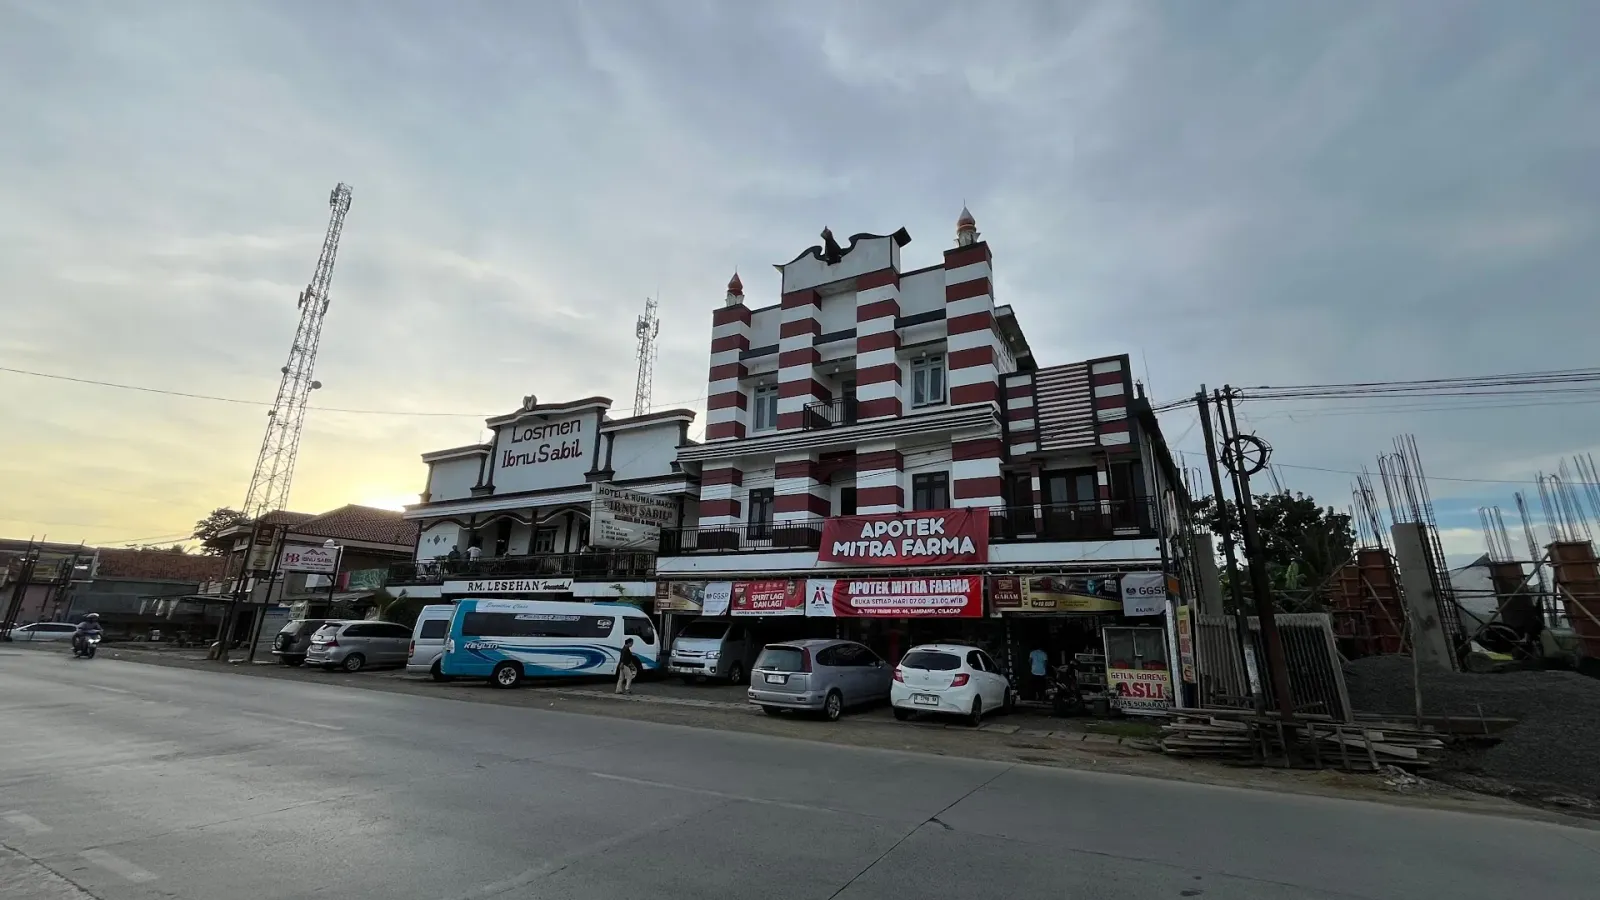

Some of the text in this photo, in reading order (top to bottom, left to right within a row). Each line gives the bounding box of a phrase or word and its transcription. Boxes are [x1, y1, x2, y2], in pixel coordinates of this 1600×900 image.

[511, 420, 581, 443] Losmen
[502, 439, 582, 468] Ibnu Sabil
[599, 487, 623, 498] HOTEL
[631, 494, 655, 505] RUMAH
[656, 499, 678, 510] MAKAN
[860, 517, 945, 539] APOTEK
[832, 536, 976, 557] MITRA FARMA
[468, 582, 485, 591] RM.
[487, 581, 540, 591] LESEHAN
[848, 579, 970, 595] APOTEK MITRA FARMA
[751, 593, 770, 602] SPIRIT
[770, 592, 785, 600] LAGI
[768, 600, 782, 608] LAGI
[1110, 672, 1167, 681] GETUK GORENG
[1117, 682, 1164, 698] ASLI
